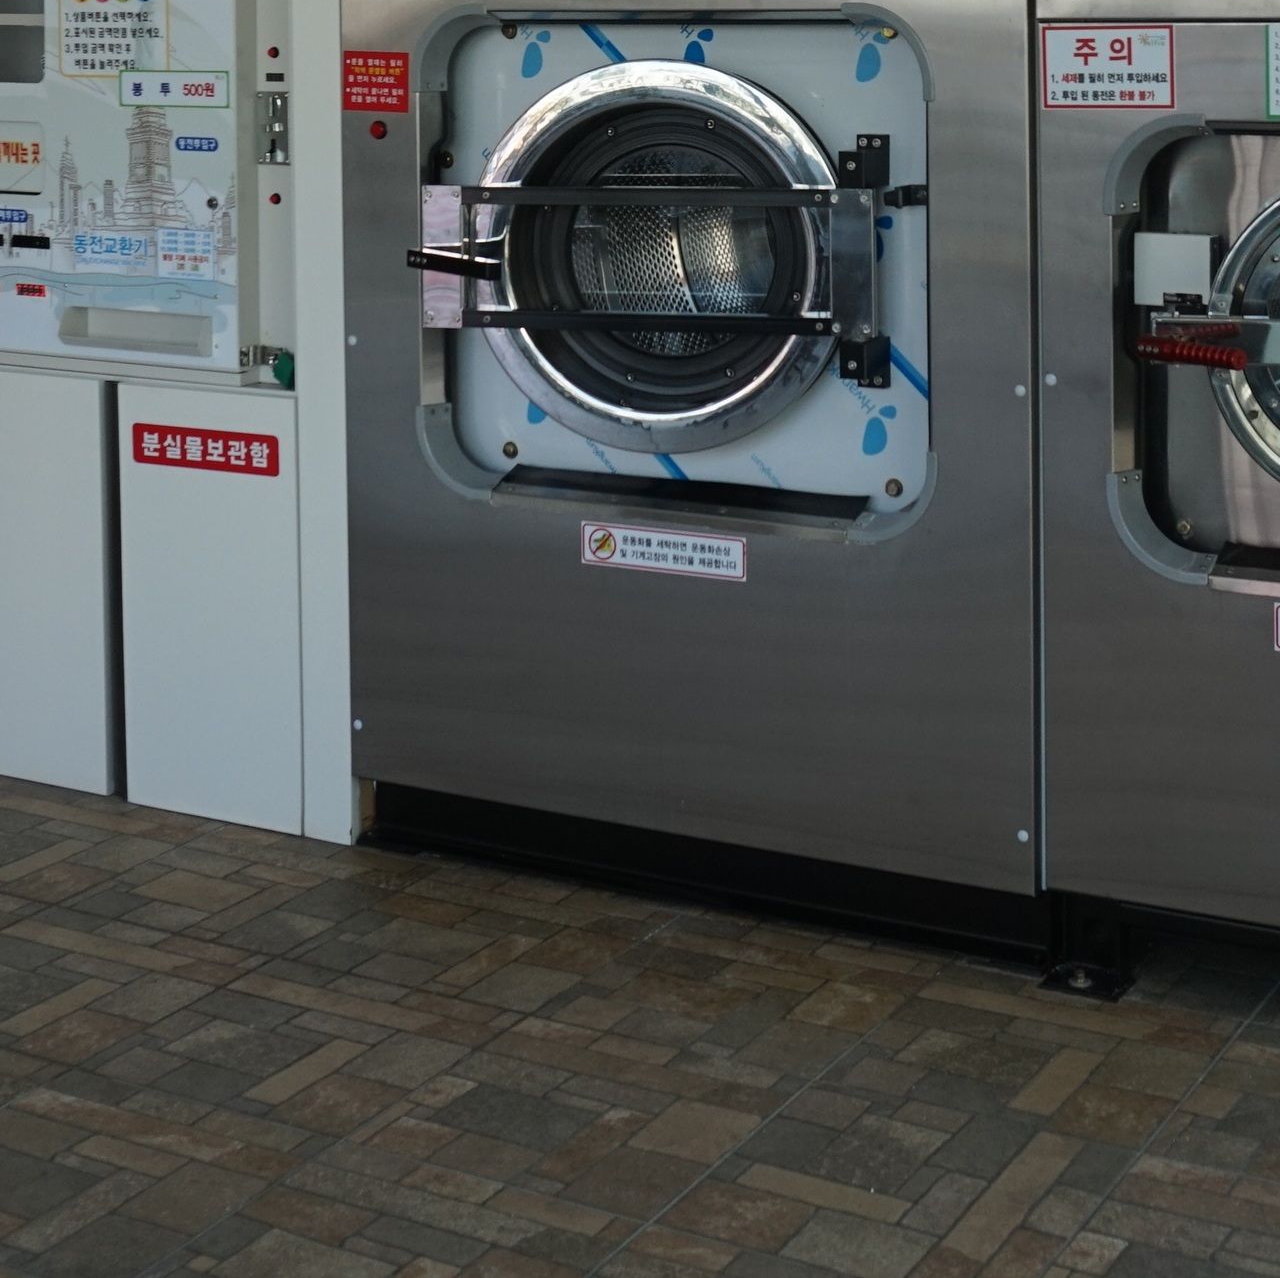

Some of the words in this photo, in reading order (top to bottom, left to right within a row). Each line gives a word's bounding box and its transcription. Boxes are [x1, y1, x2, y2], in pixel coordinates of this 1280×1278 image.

[183, 83, 215, 97] 500원
[75, 235, 148, 256] 동전교환기
[142, 433, 270, 467] 분실물보관함
